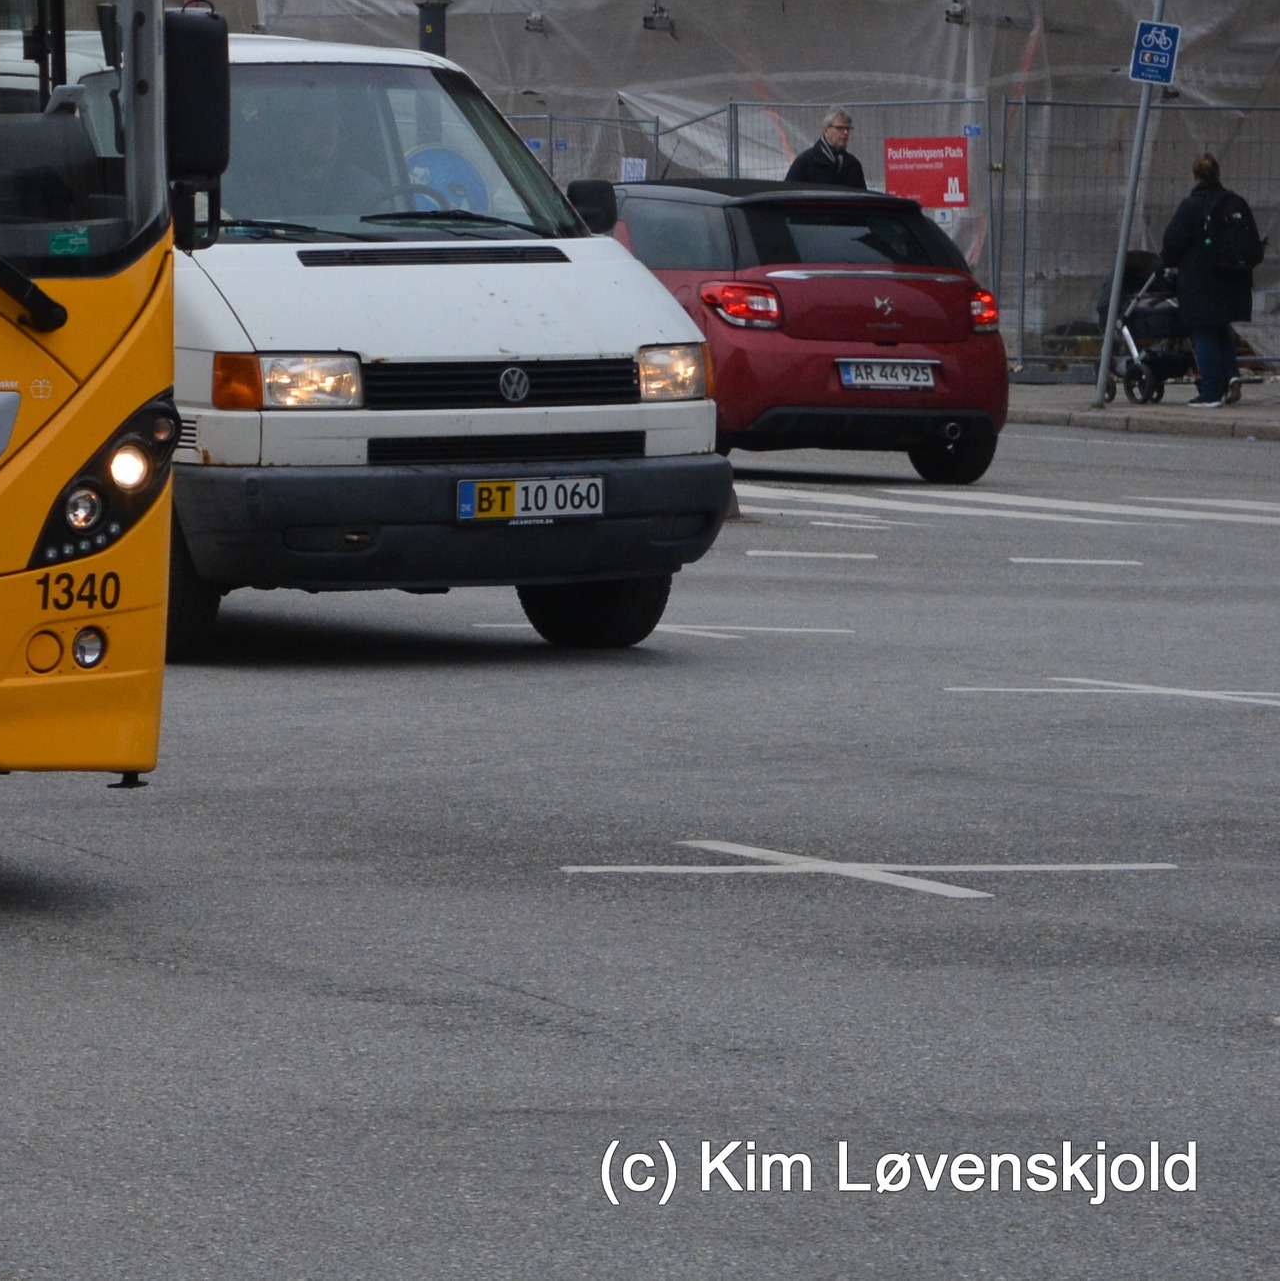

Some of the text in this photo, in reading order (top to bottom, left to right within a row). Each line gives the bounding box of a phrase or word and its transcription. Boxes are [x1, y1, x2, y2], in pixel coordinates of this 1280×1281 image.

[888, 146, 964, 161] Poul Henningsens Plads
[854, 364, 931, 382] AR 44 925
[477, 482, 600, 513] BT 10 060
[460, 504, 472, 512] DK
[36, 571, 121, 611] 1340
